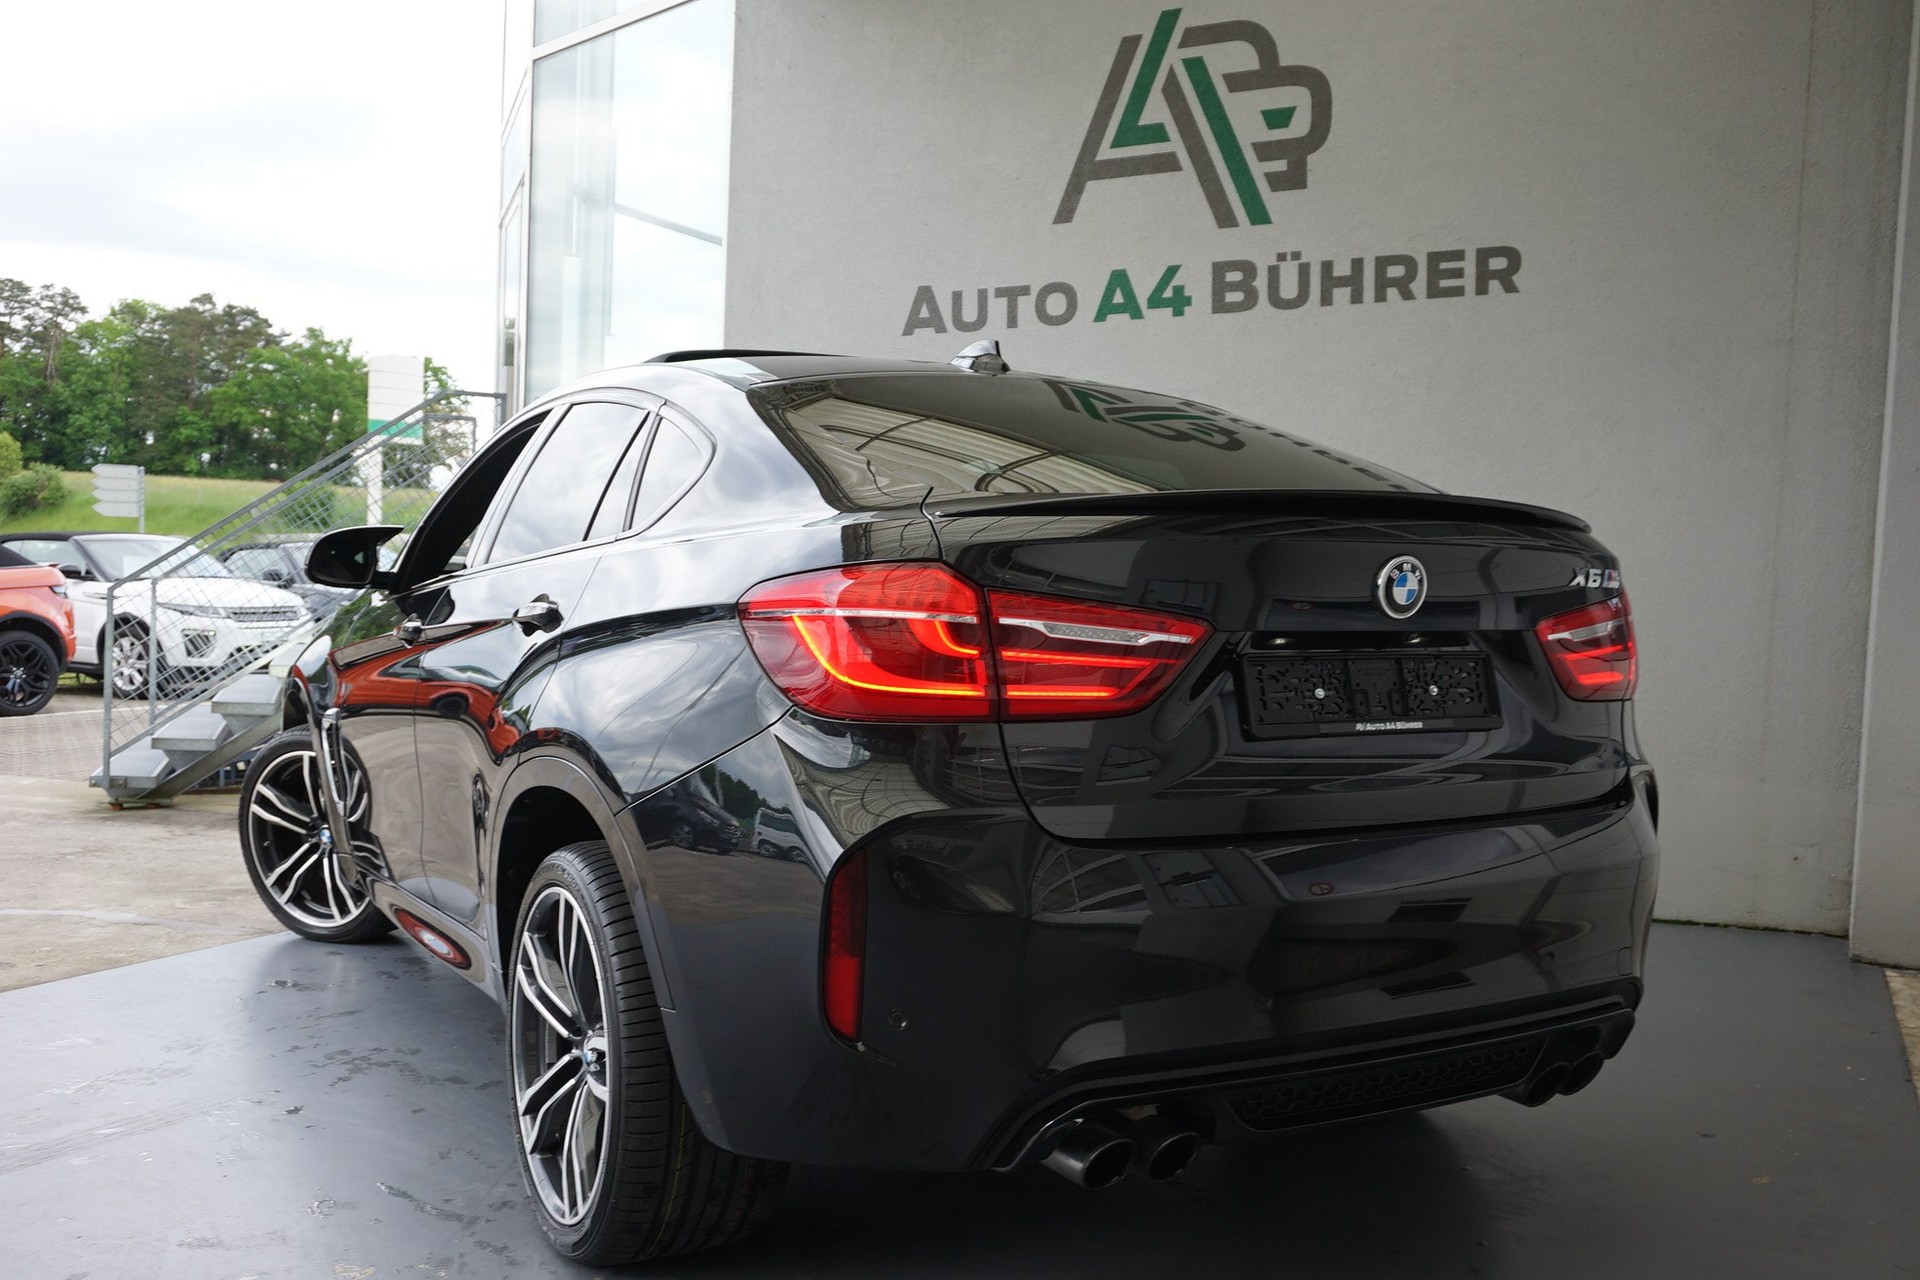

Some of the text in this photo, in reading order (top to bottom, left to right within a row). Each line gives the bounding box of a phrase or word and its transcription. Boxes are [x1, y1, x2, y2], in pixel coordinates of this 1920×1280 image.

[901, 245, 1522, 336] AUTO A4 BÜHRER
